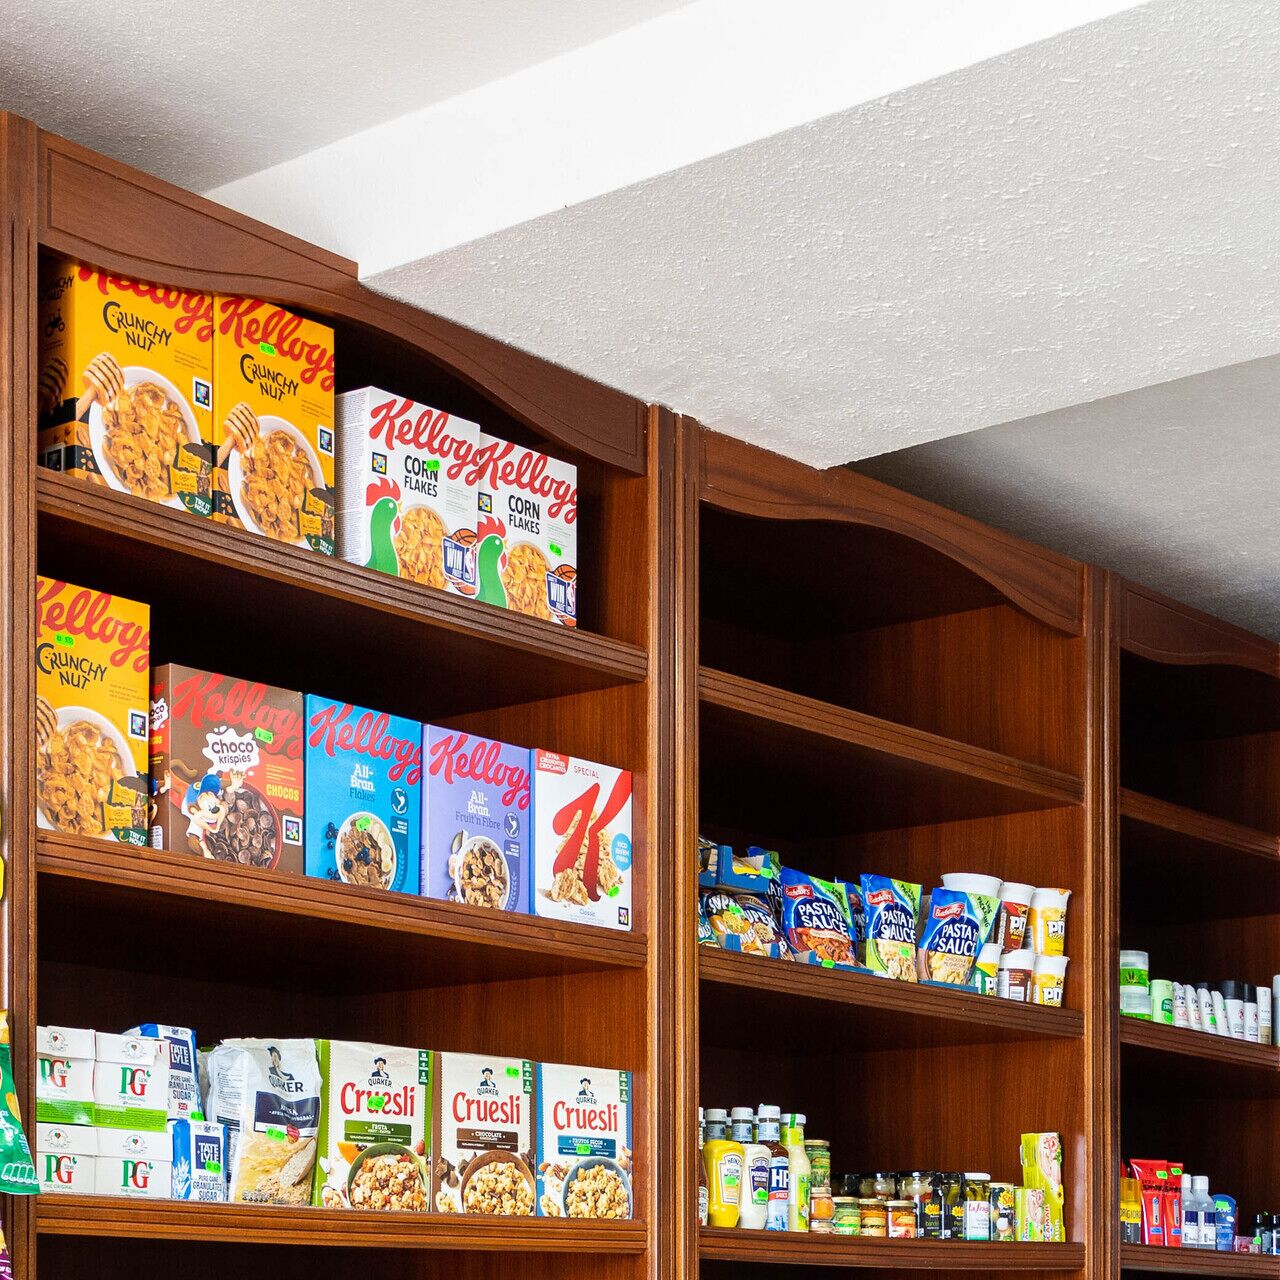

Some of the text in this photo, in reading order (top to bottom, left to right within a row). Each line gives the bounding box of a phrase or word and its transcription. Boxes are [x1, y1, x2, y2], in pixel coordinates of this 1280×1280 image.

[102, 301, 173, 347] CRUNCHY
[126, 331, 156, 353] NUT
[239, 353, 300, 397] CRUNCHY
[259, 382, 287, 402] NUT
[404, 474, 438, 498] FLAKES
[508, 495, 541, 518] CORN
[508, 513, 541, 536] FLAKES
[36, 642, 108, 683] CRUNCHY
[60, 671, 89, 691] NUT
[211, 739, 254, 756] choco
[219, 751, 253, 767] krispies
[351, 776, 375, 790] Bran
[573, 765, 599, 780] SPECIAL
[266, 783, 299, 802] CHOCOS
[349, 788, 375, 802] Flakes
[466, 801, 490, 815] Bran
[798, 902, 830, 917] PASTA
[880, 910, 907, 924] PASTA
[801, 915, 847, 936] SAUCE
[941, 924, 968, 939] PASTA
[39, 1059, 67, 1088] PG
[120, 1066, 146, 1096] PG
[452, 1092, 520, 1125] Cruesli
[552, 1101, 618, 1132] Cruesli
[44, 1154, 73, 1185] PG
[121, 1159, 148, 1188] PG
